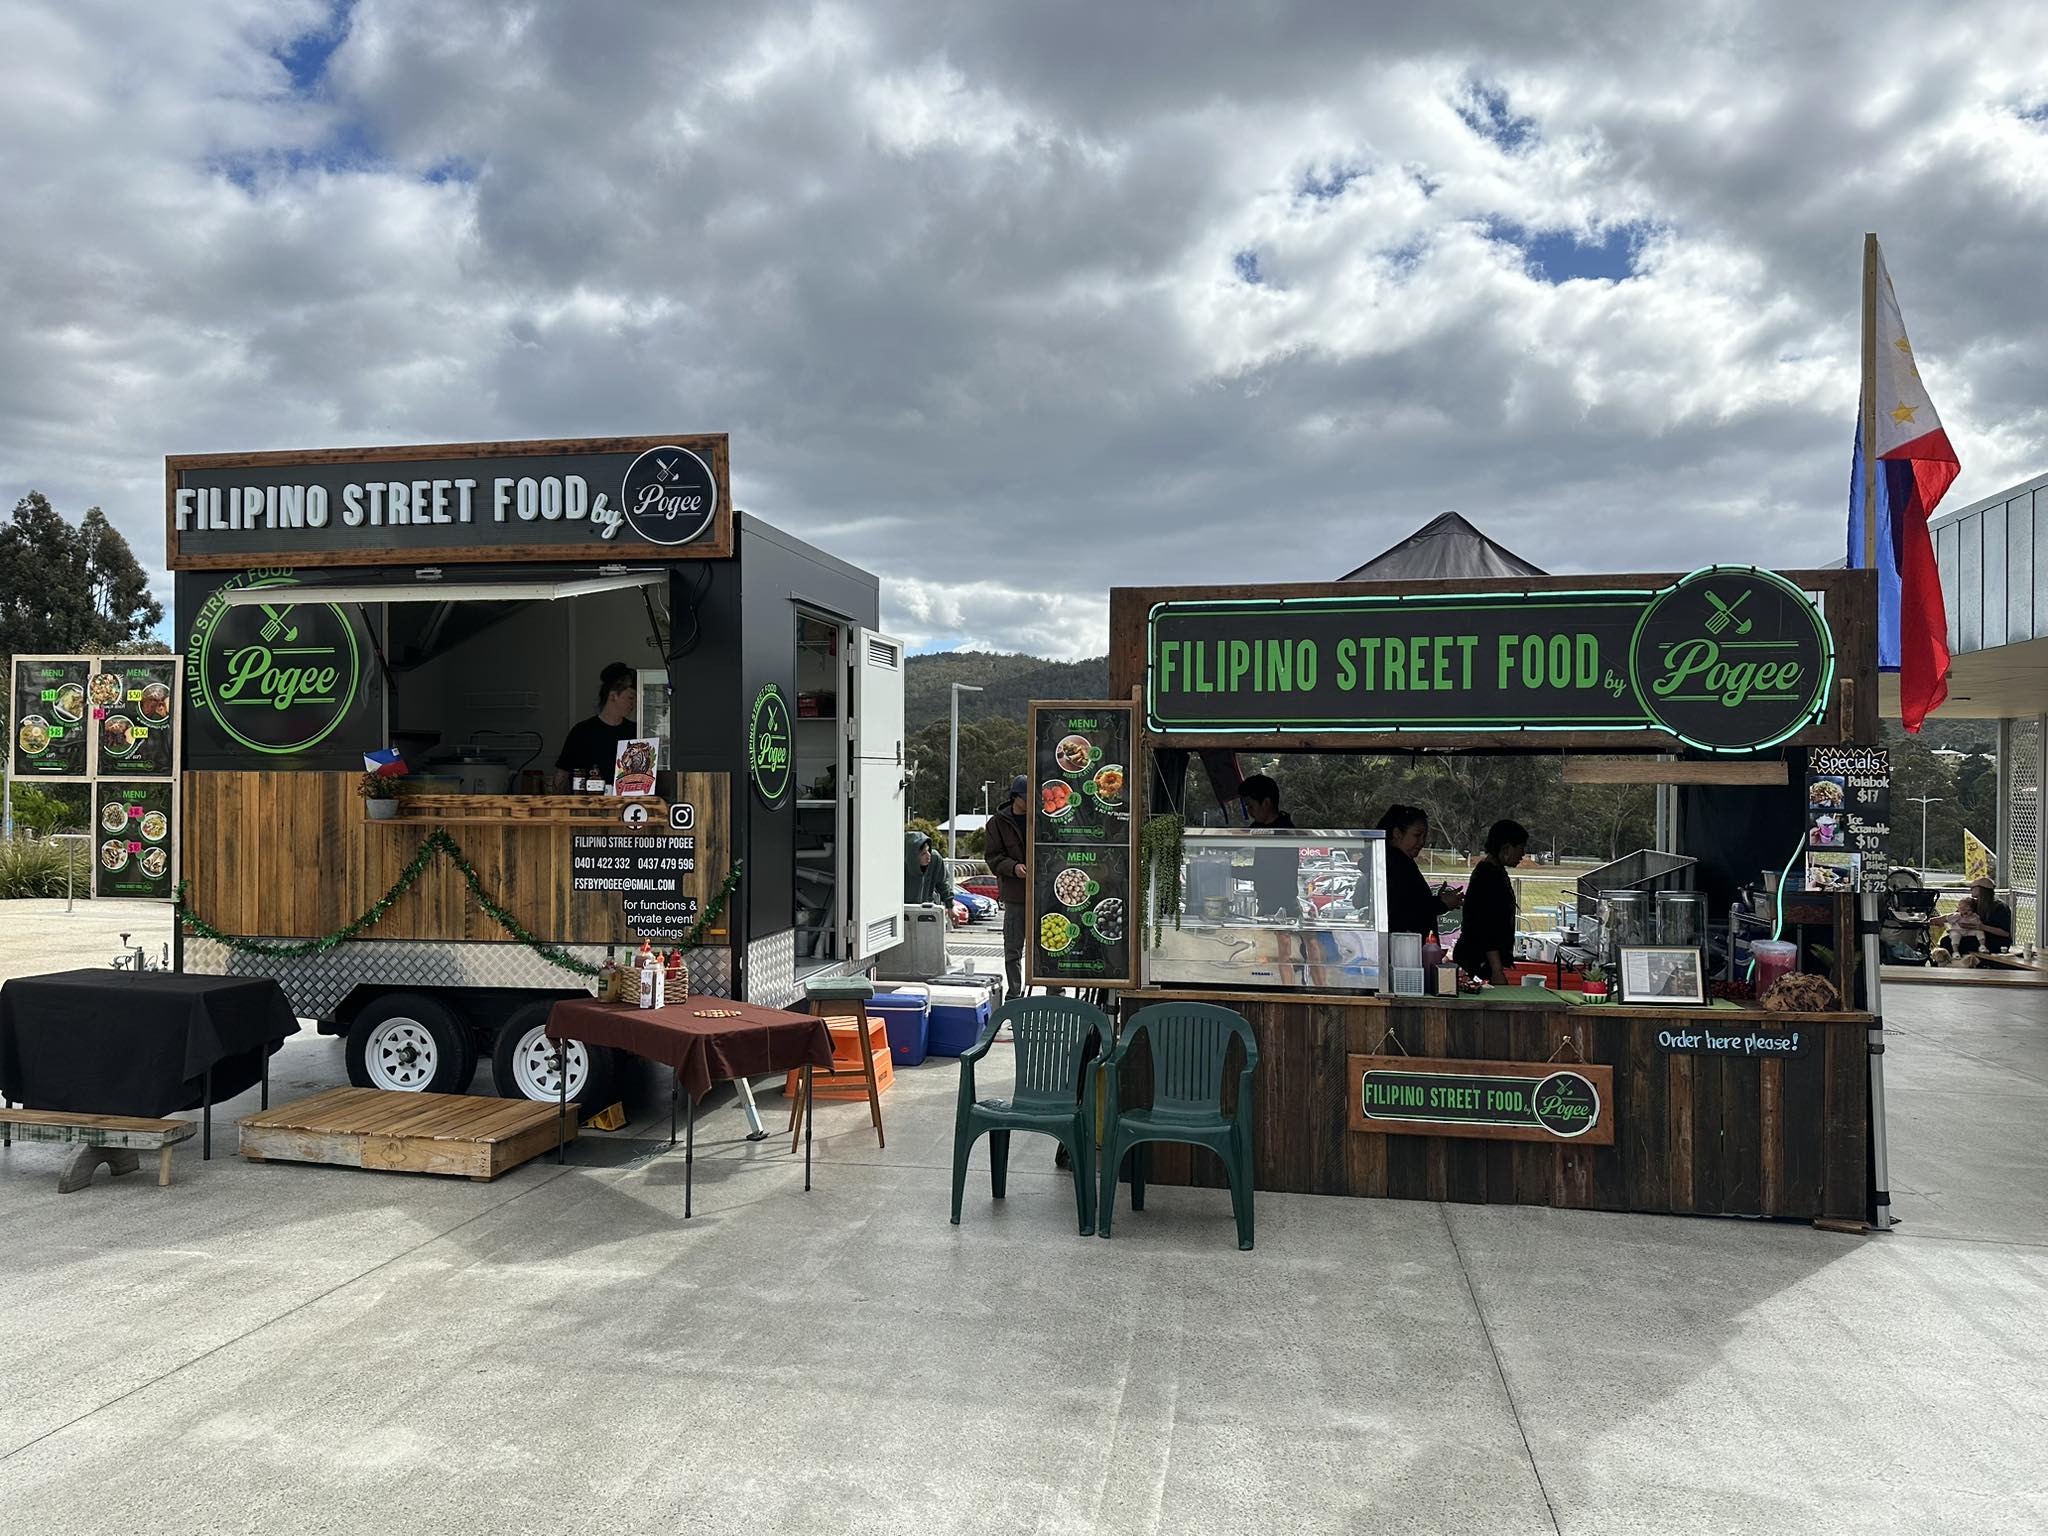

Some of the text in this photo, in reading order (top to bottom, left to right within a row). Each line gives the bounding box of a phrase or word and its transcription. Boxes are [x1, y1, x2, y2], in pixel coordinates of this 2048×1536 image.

[176, 475, 624, 539] FILIPINO STREET FOOD by
[633, 484, 702, 520] Pogee
[187, 633, 206, 708] FILIPINO
[248, 567, 294, 582] FOOD
[1161, 633, 1627, 698] FILIPINO STREET FOOD by
[41, 669, 64, 677] MENU
[126, 668, 149, 677] MENU
[219, 645, 340, 711] Pogee
[1652, 638, 1806, 707] Pogee
[1068, 719, 1098, 728] MENU
[758, 732, 786, 772] Pogee
[1818, 753, 1880, 770] Specials
[1847, 775, 1890, 788] Palabok
[122, 791, 146, 799] MENU
[1856, 788, 1879, 803] $17
[1846, 813, 1864, 825] Ice
[1848, 822, 1890, 834] Scramble
[574, 836, 694, 849] FILIPINO STREE FOOD BY POGEE
[1856, 834, 1880, 849] $10
[1067, 852, 1097, 861] MENU
[1299, 847, 1320, 856] oles
[1861, 851, 1887, 861] Drink
[574, 857, 694, 870] 0401 422 332 0437 479 596
[1861, 870, 1887, 881] Combo
[574, 878, 675, 891] FSFBYPOGEE@GMAIL.COM
[1862, 880, 1887, 893] $25
[624, 900, 698, 911] for functions &
[627, 914, 694, 925] private event
[637, 927, 684, 939] bookings
[1658, 1030, 1799, 1054] Order here please!
[1365, 1084, 1533, 1116] FILIPINO STREET FOOD by
[1539, 1095, 1591, 1121] Pogee
